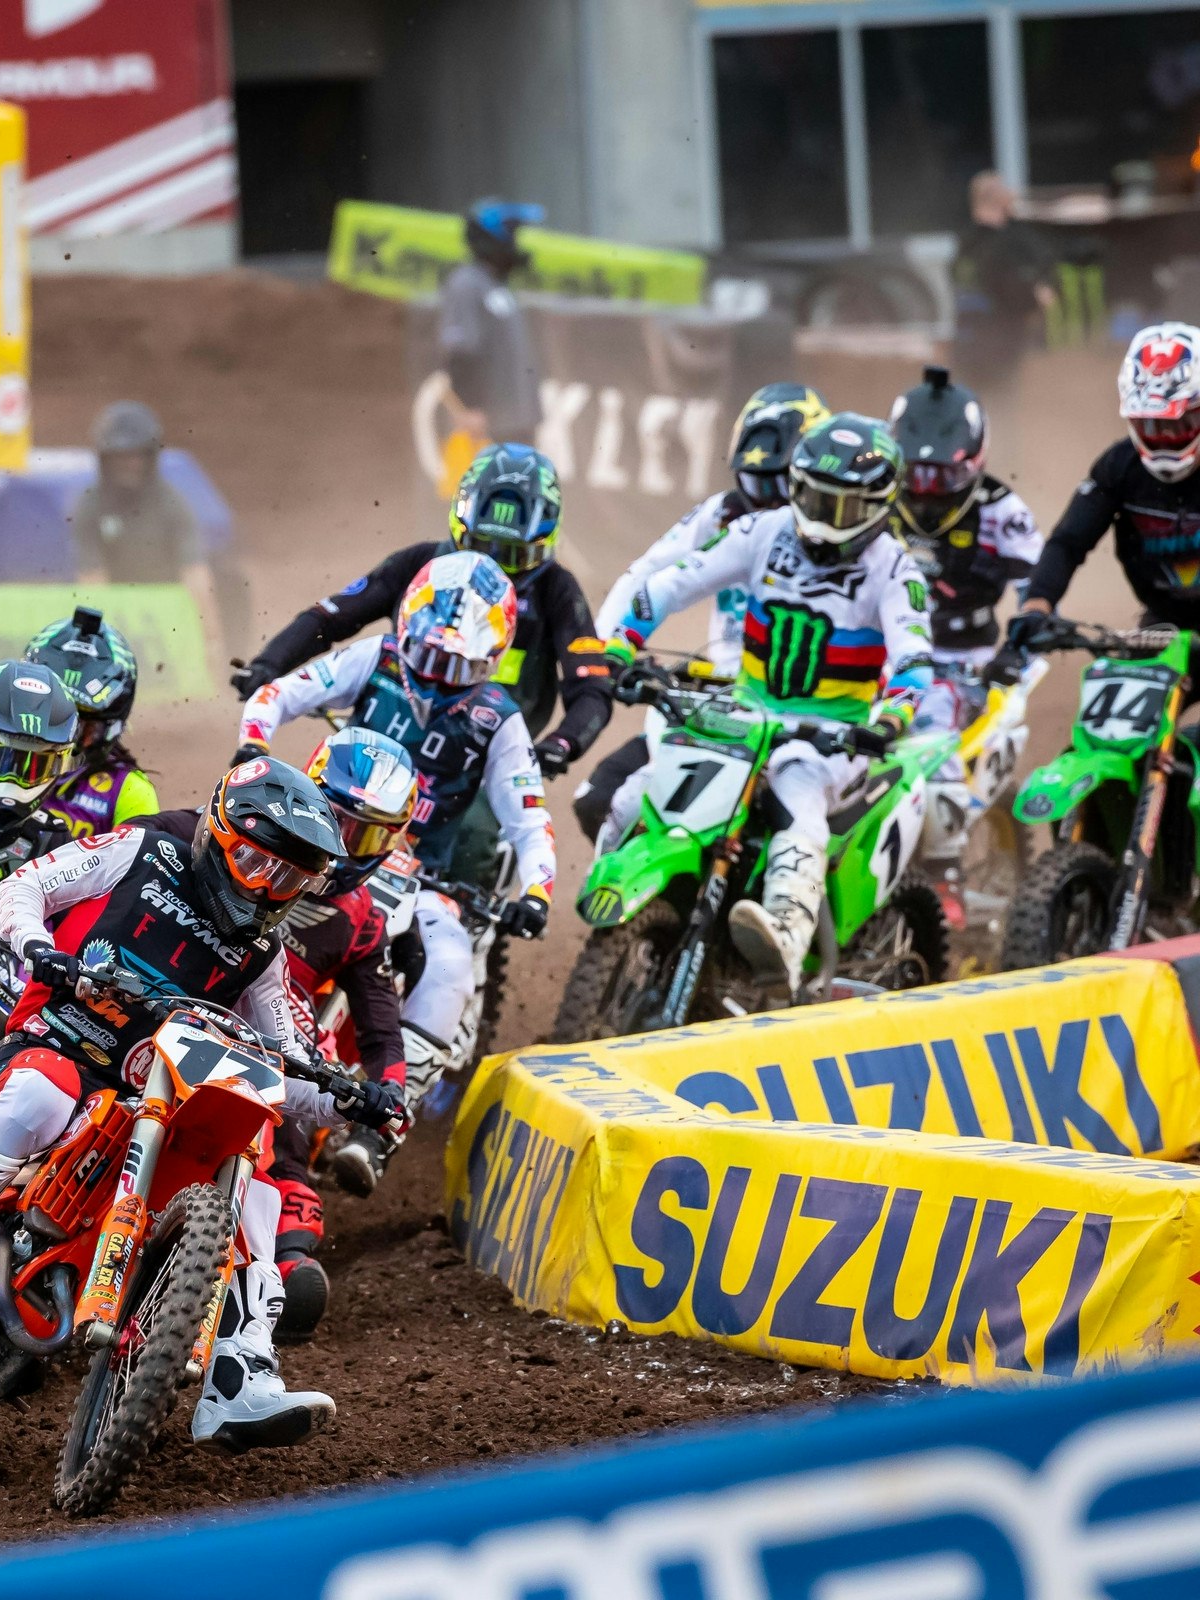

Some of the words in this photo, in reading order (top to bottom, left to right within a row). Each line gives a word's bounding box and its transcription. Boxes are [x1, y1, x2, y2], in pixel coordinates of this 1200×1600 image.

[412, 371, 722, 498] OKLEY
[19, 680, 44, 691] BELL
[1081, 682, 1158, 733] 44
[665, 759, 726, 813] 1
[81, 855, 101, 872] CBD
[880, 817, 904, 888] 1
[162, 889, 196, 917] ROCKY
[60, 1004, 118, 1047] Palmetto
[270, 999, 287, 1033] SWEET
[177, 1036, 283, 1092] 17
[675, 1014, 1164, 1156] SUZUKI
[113, 1234, 135, 1295] DUNOP
[614, 1156, 1112, 1377] SUZUKI
